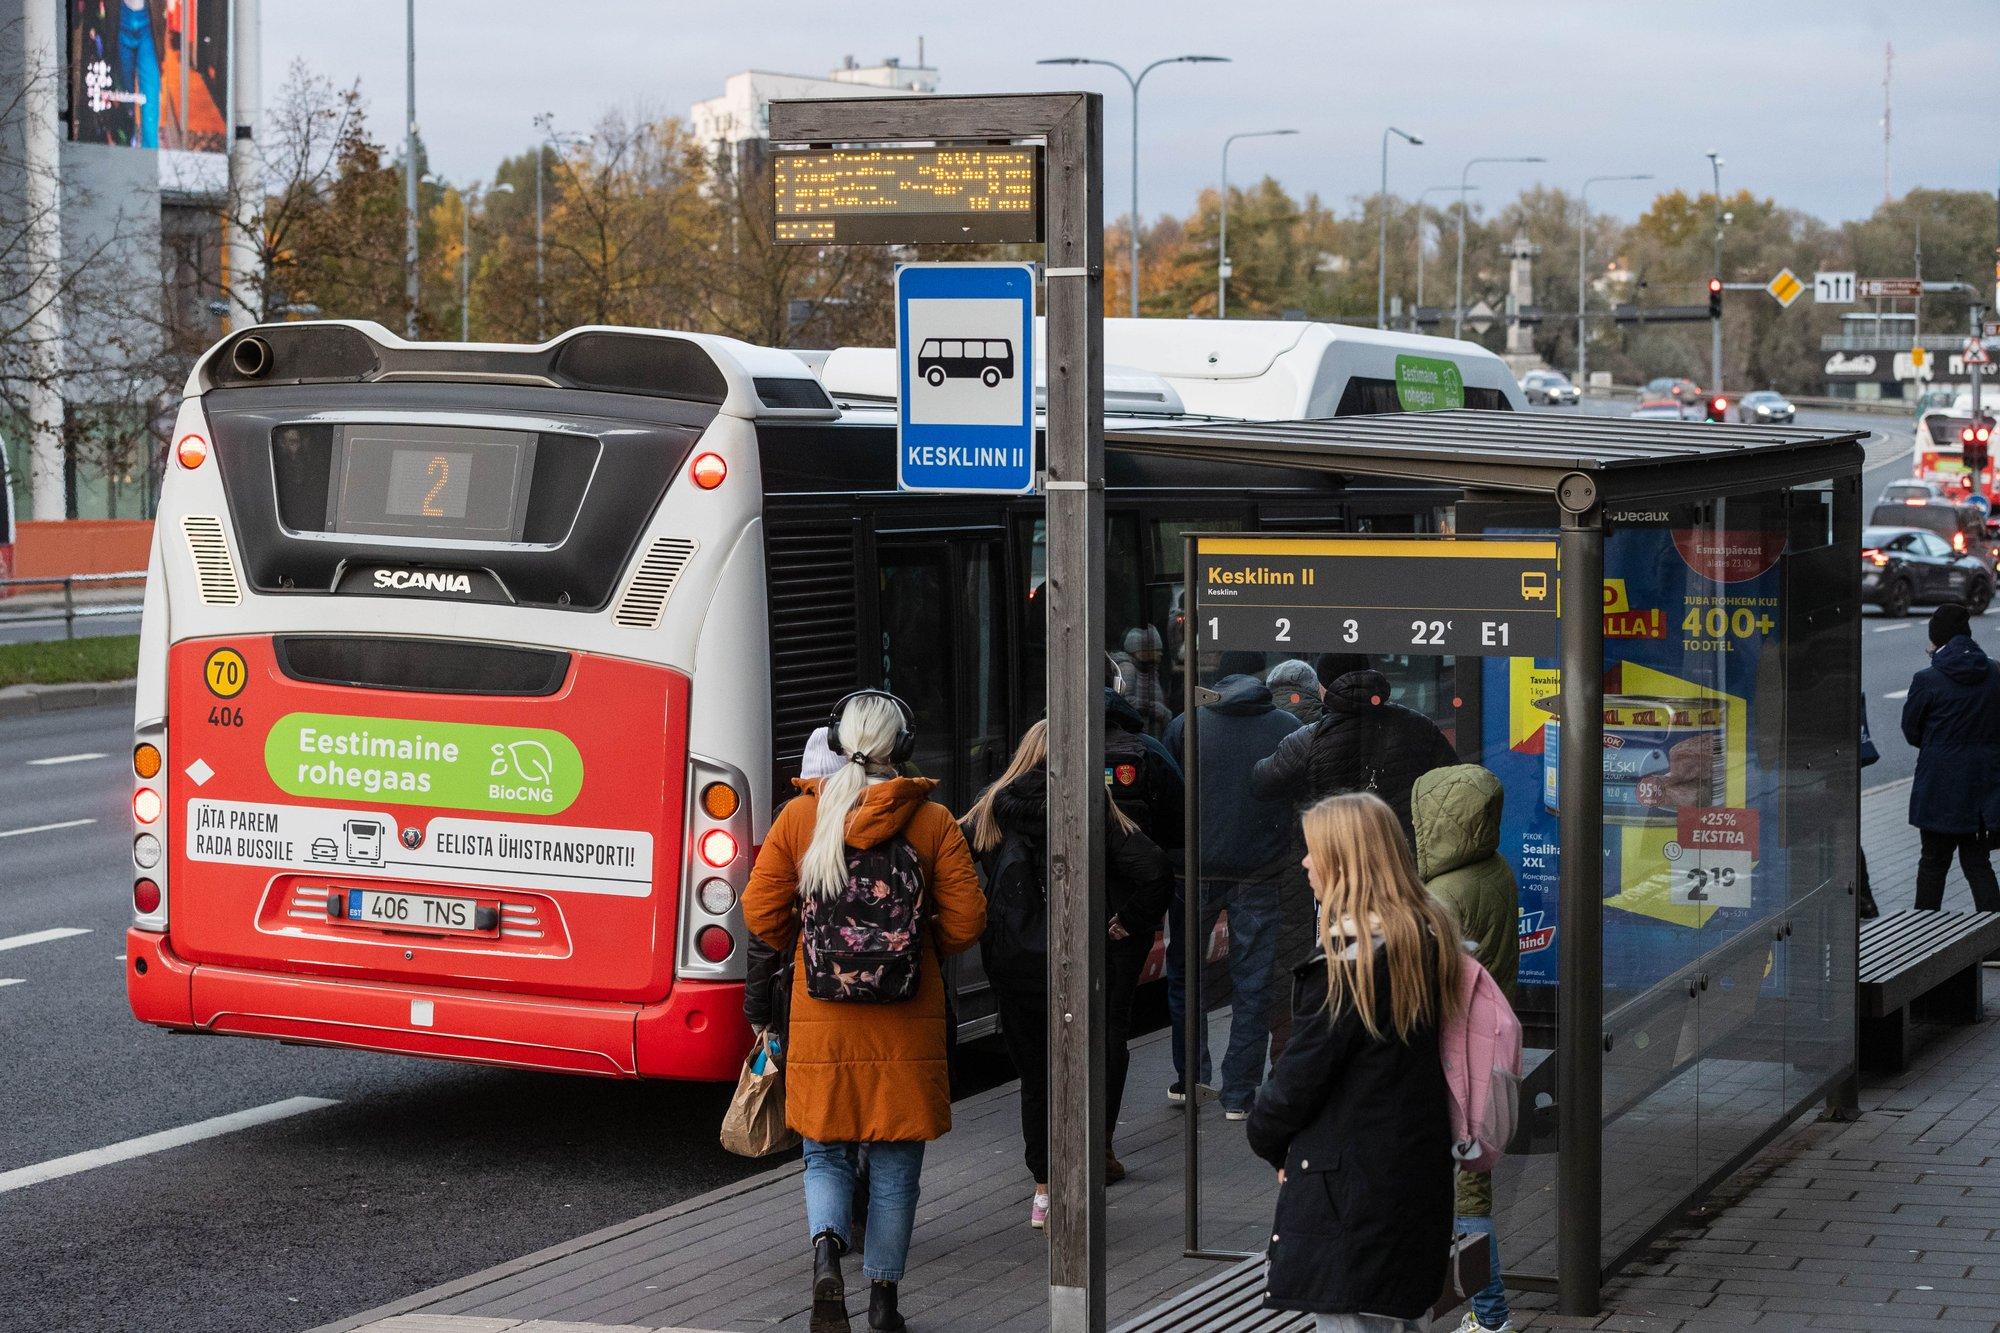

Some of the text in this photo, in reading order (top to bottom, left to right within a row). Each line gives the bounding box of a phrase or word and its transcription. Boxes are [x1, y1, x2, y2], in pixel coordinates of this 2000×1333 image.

[908, 446, 1024, 468] KESKLINN II
[422, 456, 449, 517] 2
[1696, 545, 1762, 556] Esmaspäevast
[1706, 559, 1729, 568] alates
[373, 569, 471, 594] SCANIA
[1208, 567, 1315, 586] Kesklinn II
[1207, 588, 1238, 596] Kesklinn
[1683, 596, 1778, 607] JUBA ROHKEM KUI
[1208, 617, 1219, 640] 1
[1275, 618, 1291, 642] 2
[1342, 619, 1359, 643] 3
[1481, 621, 1510, 646] E1
[1603, 608, 1660, 638] LLA!
[1681, 607, 1775, 638] 400+
[1682, 640, 1735, 652] TOOTEL
[213, 660, 239, 686] 70
[1535, 688, 1544, 697] kg
[207, 707, 244, 728] 406
[300, 729, 459, 763] Eestimaine
[298, 759, 431, 794] rohegaas
[489, 785, 554, 803] BioCNG
[196, 807, 279, 834] JÄTA PAREM
[1700, 812, 1737, 826] +25%
[196, 834, 294, 862] RADA BUSSILE
[1692, 830, 1745, 844] EKSTRA
[436, 832, 636, 868] EELISTA ÜHISTRANSPORTI!
[1522, 857, 1546, 868] XXL
[349, 895, 467, 927] EST 406 TNS
